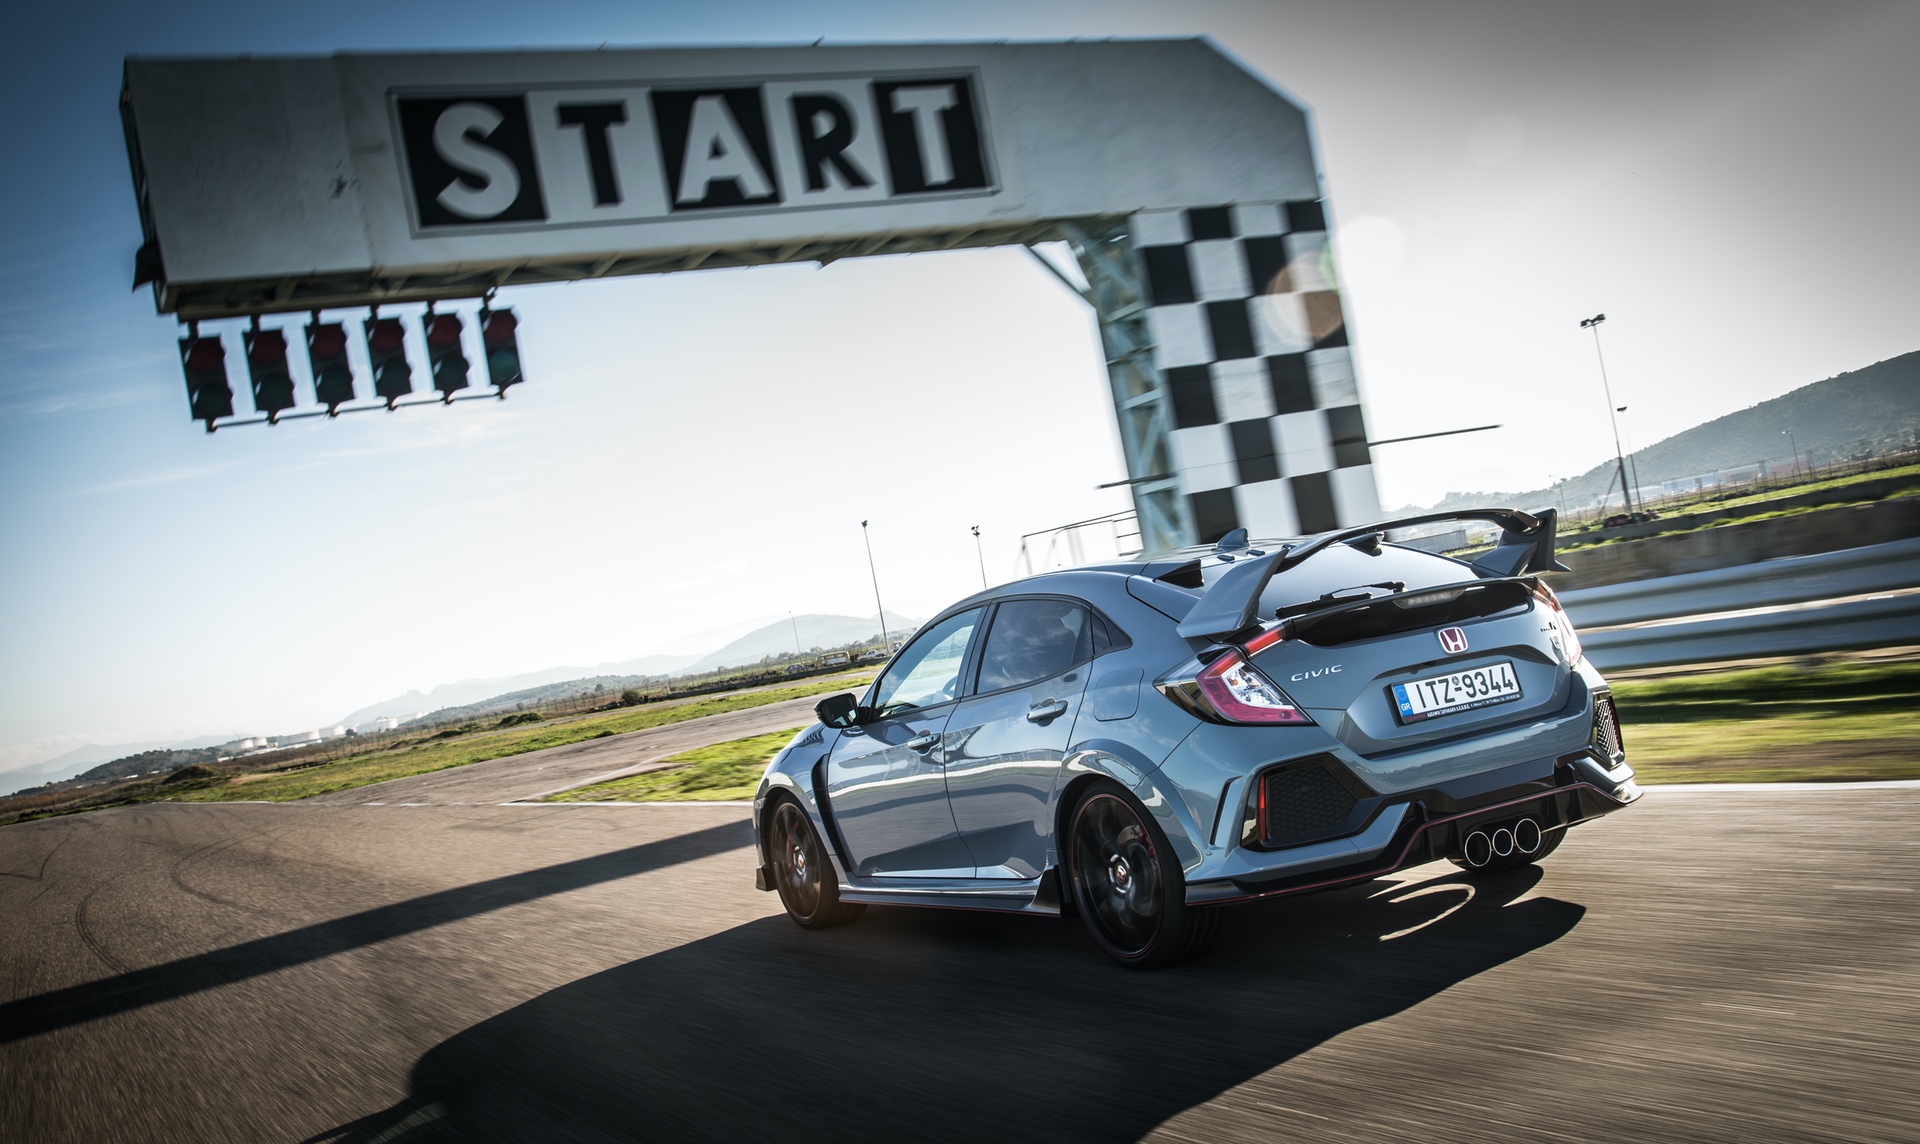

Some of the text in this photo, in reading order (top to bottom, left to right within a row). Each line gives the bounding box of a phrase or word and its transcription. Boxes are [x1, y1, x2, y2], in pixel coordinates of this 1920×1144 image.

[431, 84, 959, 220] START
[1290, 664, 1343, 682] CIVIC
[1400, 702, 1412, 711] GR
